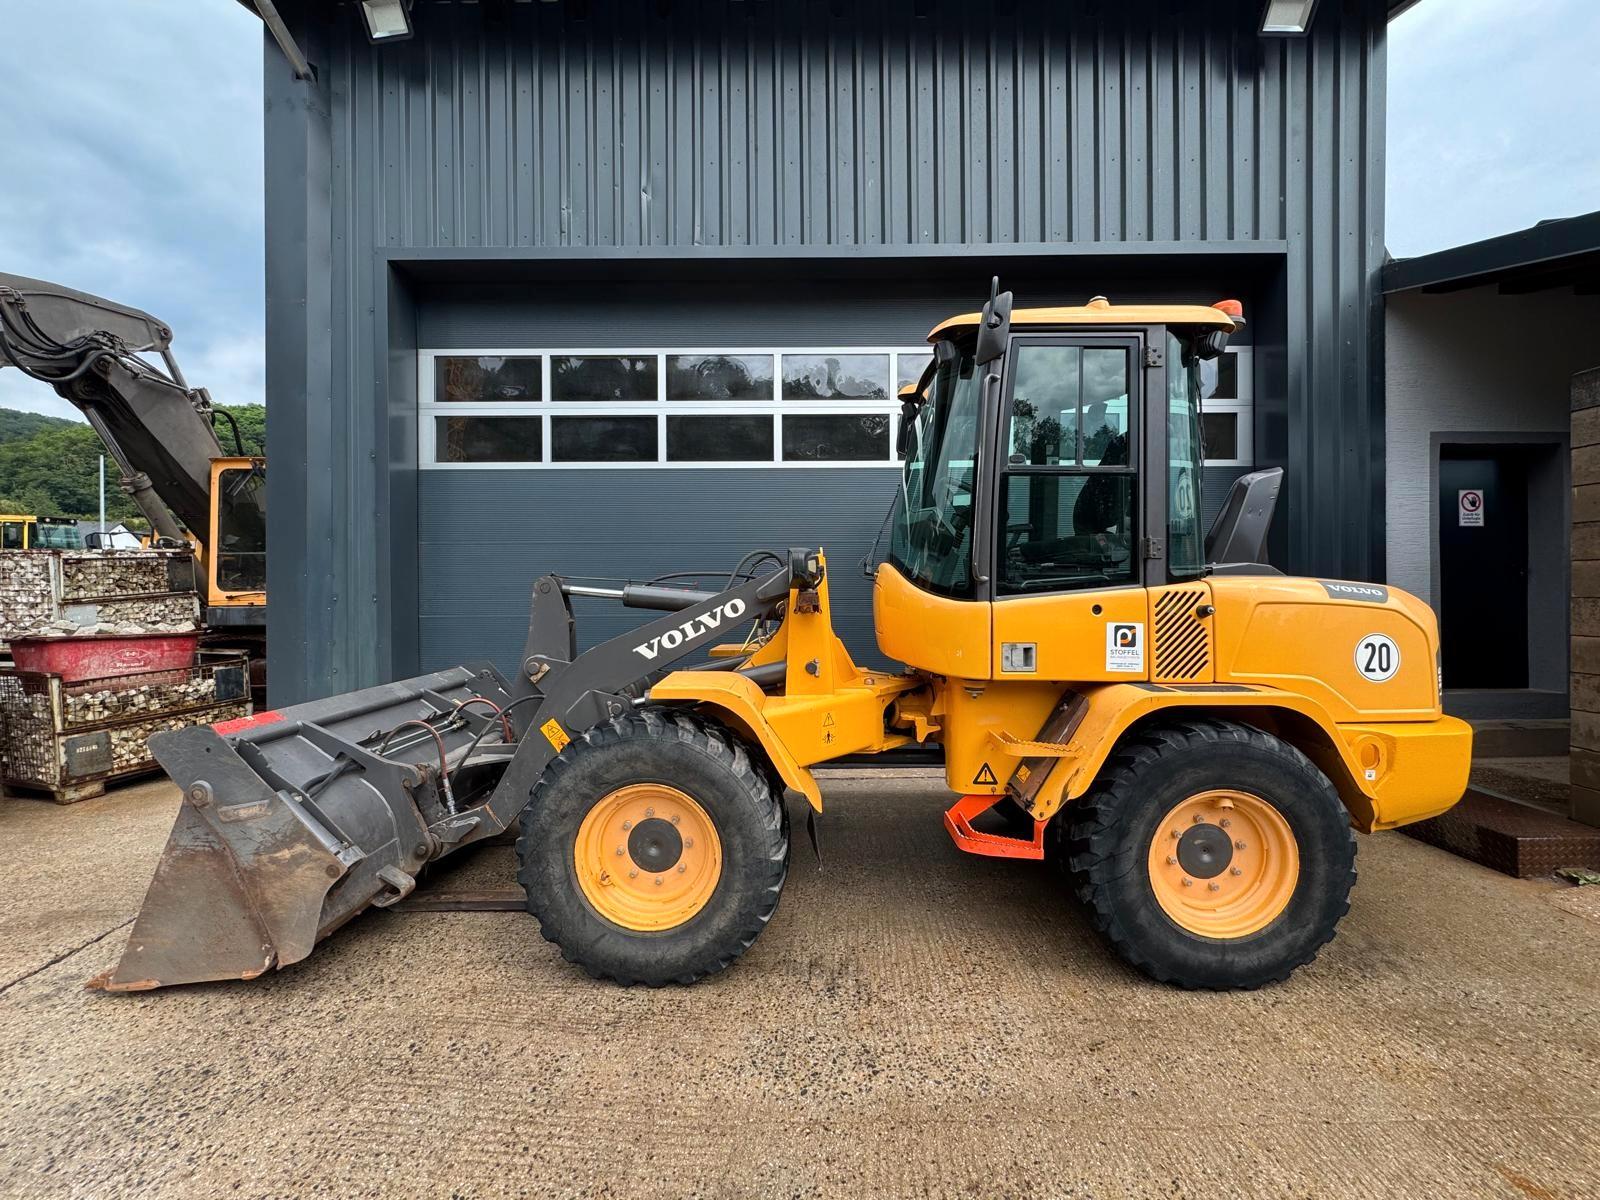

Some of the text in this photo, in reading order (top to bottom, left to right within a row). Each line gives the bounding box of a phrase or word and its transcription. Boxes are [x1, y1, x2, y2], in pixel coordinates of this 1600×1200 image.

[1325, 584, 1384, 597] VOLVO
[632, 598, 746, 660] VOLVO
[1363, 642, 1391, 673] 20
